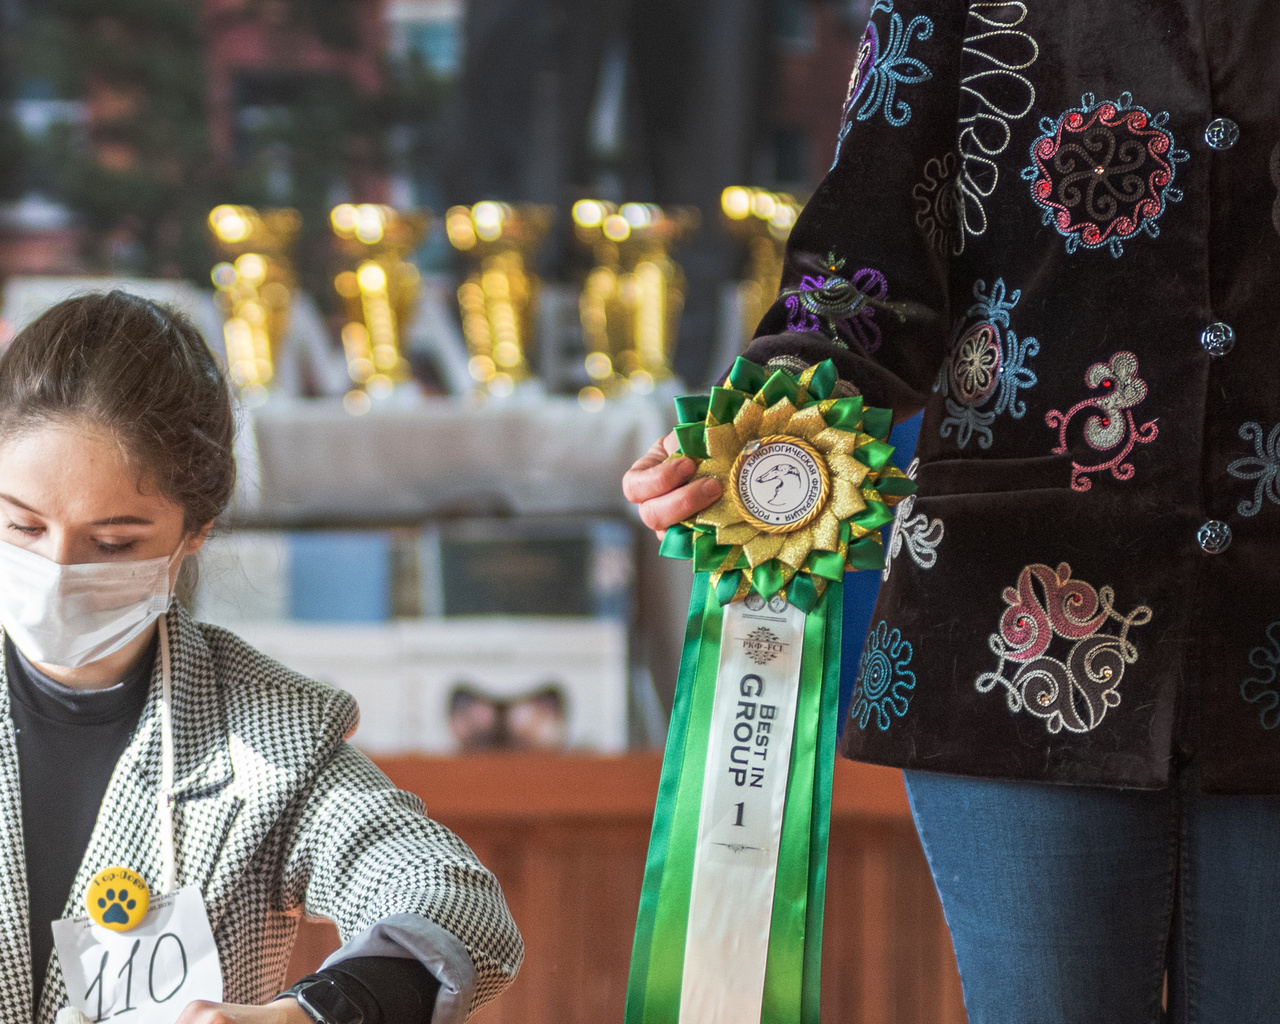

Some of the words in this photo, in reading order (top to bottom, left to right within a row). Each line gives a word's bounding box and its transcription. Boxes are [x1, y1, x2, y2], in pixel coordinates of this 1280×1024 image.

[747, 444, 817, 475] КИНОЛОГИЧЕСКАЯ
[740, 468, 771, 521] РОССИЙСКАЯ
[784, 477, 819, 522] ФЕДЕРАЦИЯ
[728, 673, 764, 787] GROUP
[753, 702, 777, 760] BEST
[749, 767, 765, 788] IN
[732, 802, 746, 828] 1
[85, 933, 188, 1024] 110
